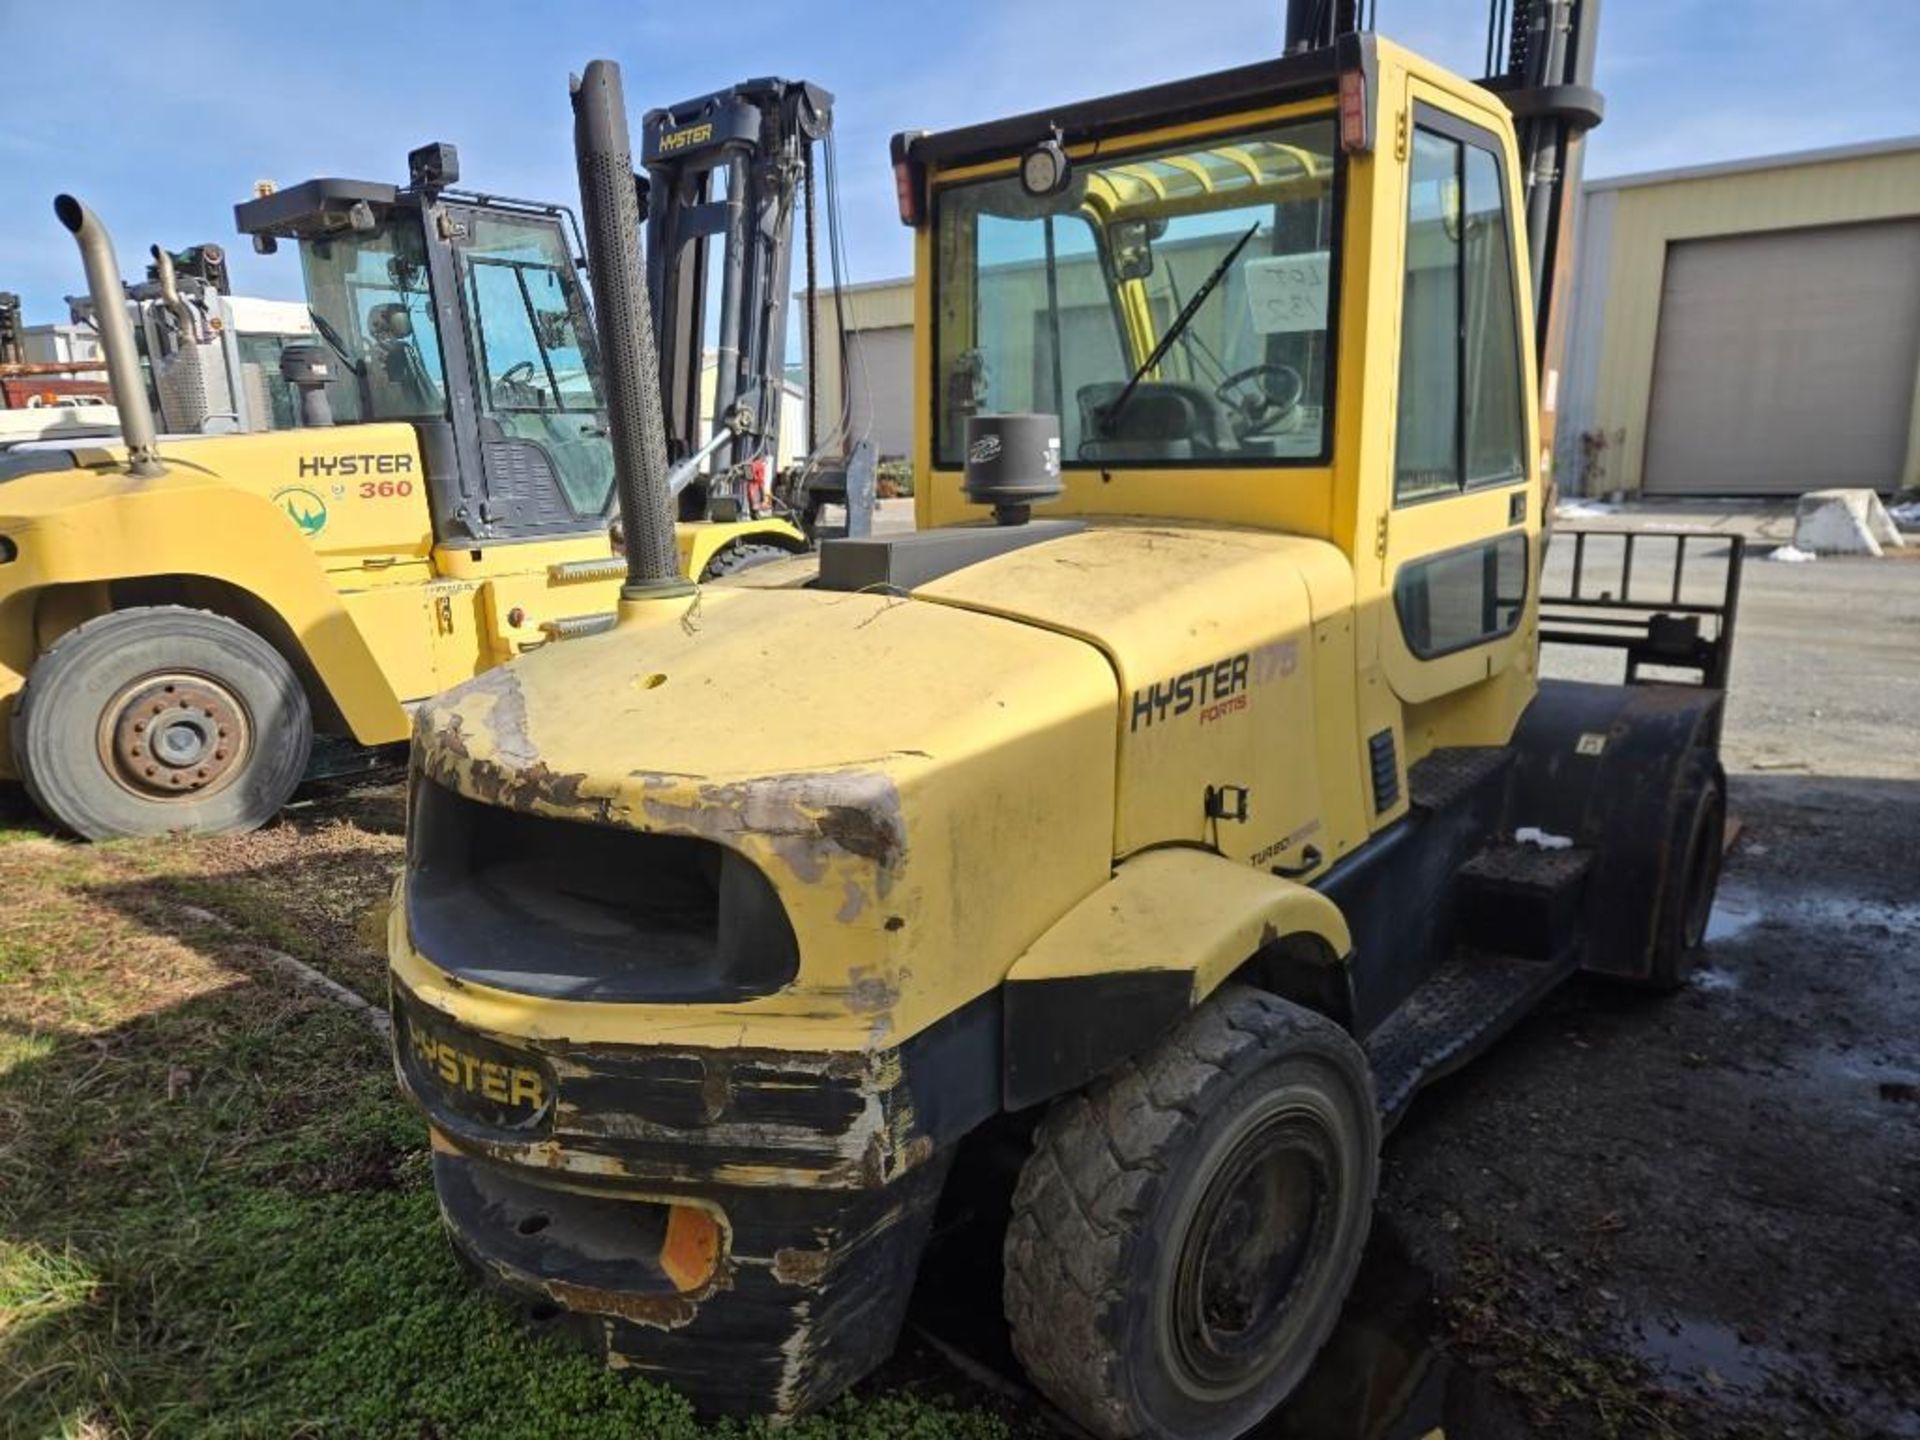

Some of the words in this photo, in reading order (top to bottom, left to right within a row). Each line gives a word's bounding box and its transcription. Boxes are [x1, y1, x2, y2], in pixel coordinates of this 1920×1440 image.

[659, 123, 713, 152] HYSTER
[299, 454, 413, 478] HYSTER
[359, 480, 413, 499] 360
[1131, 653, 1250, 734] HYSTER
[1200, 695, 1248, 725] FORTIS
